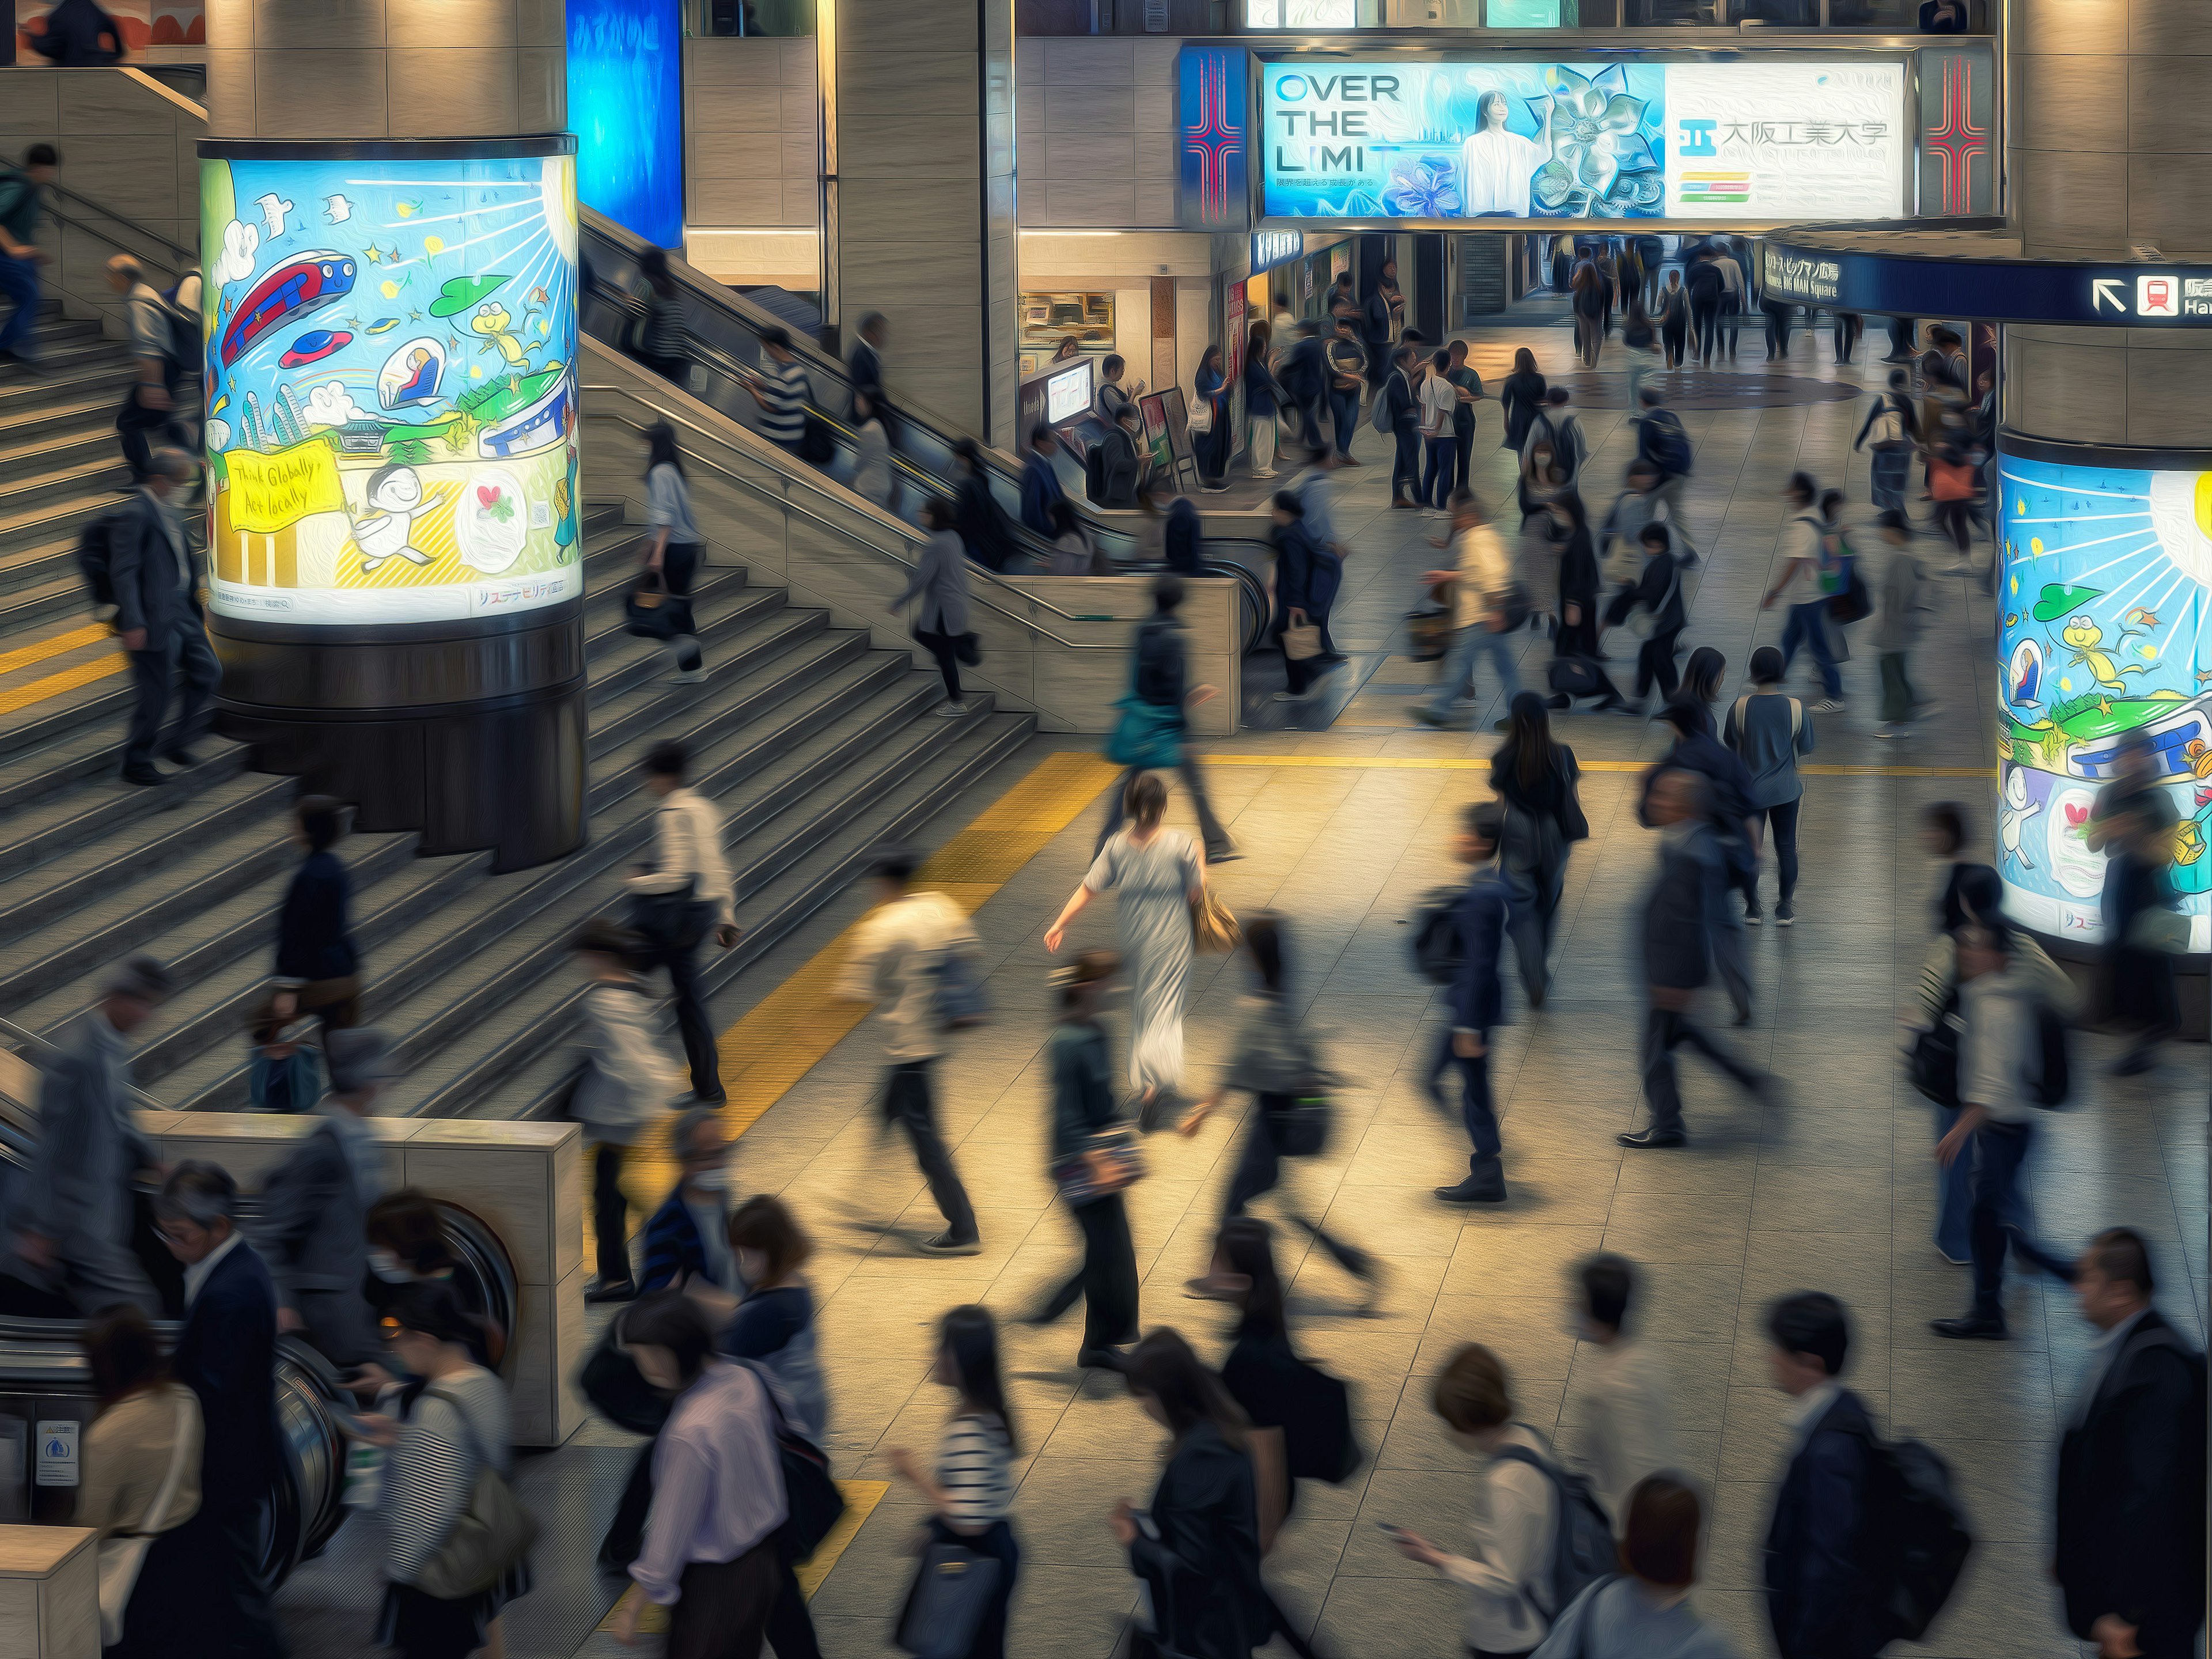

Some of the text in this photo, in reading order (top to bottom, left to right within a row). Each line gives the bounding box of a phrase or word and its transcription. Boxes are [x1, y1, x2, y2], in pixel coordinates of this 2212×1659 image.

[1275, 75, 1400, 102] OVER
[1276, 111, 1369, 137] THE
[1722, 119, 1888, 146] 大阪工業大学
[1276, 146, 1400, 172] LIMIT
[1276, 178, 1373, 187] 限界を超える成長がある
[1783, 275, 1793, 291] BIG
[1793, 278, 1809, 294] MAN
[1810, 280, 1837, 299] Square
[1023, 396, 1040, 416] Umeda
[234, 458, 321, 487] Think Globally,
[245, 488, 307, 516] Act locally
[265, 600, 281, 608] 検索
